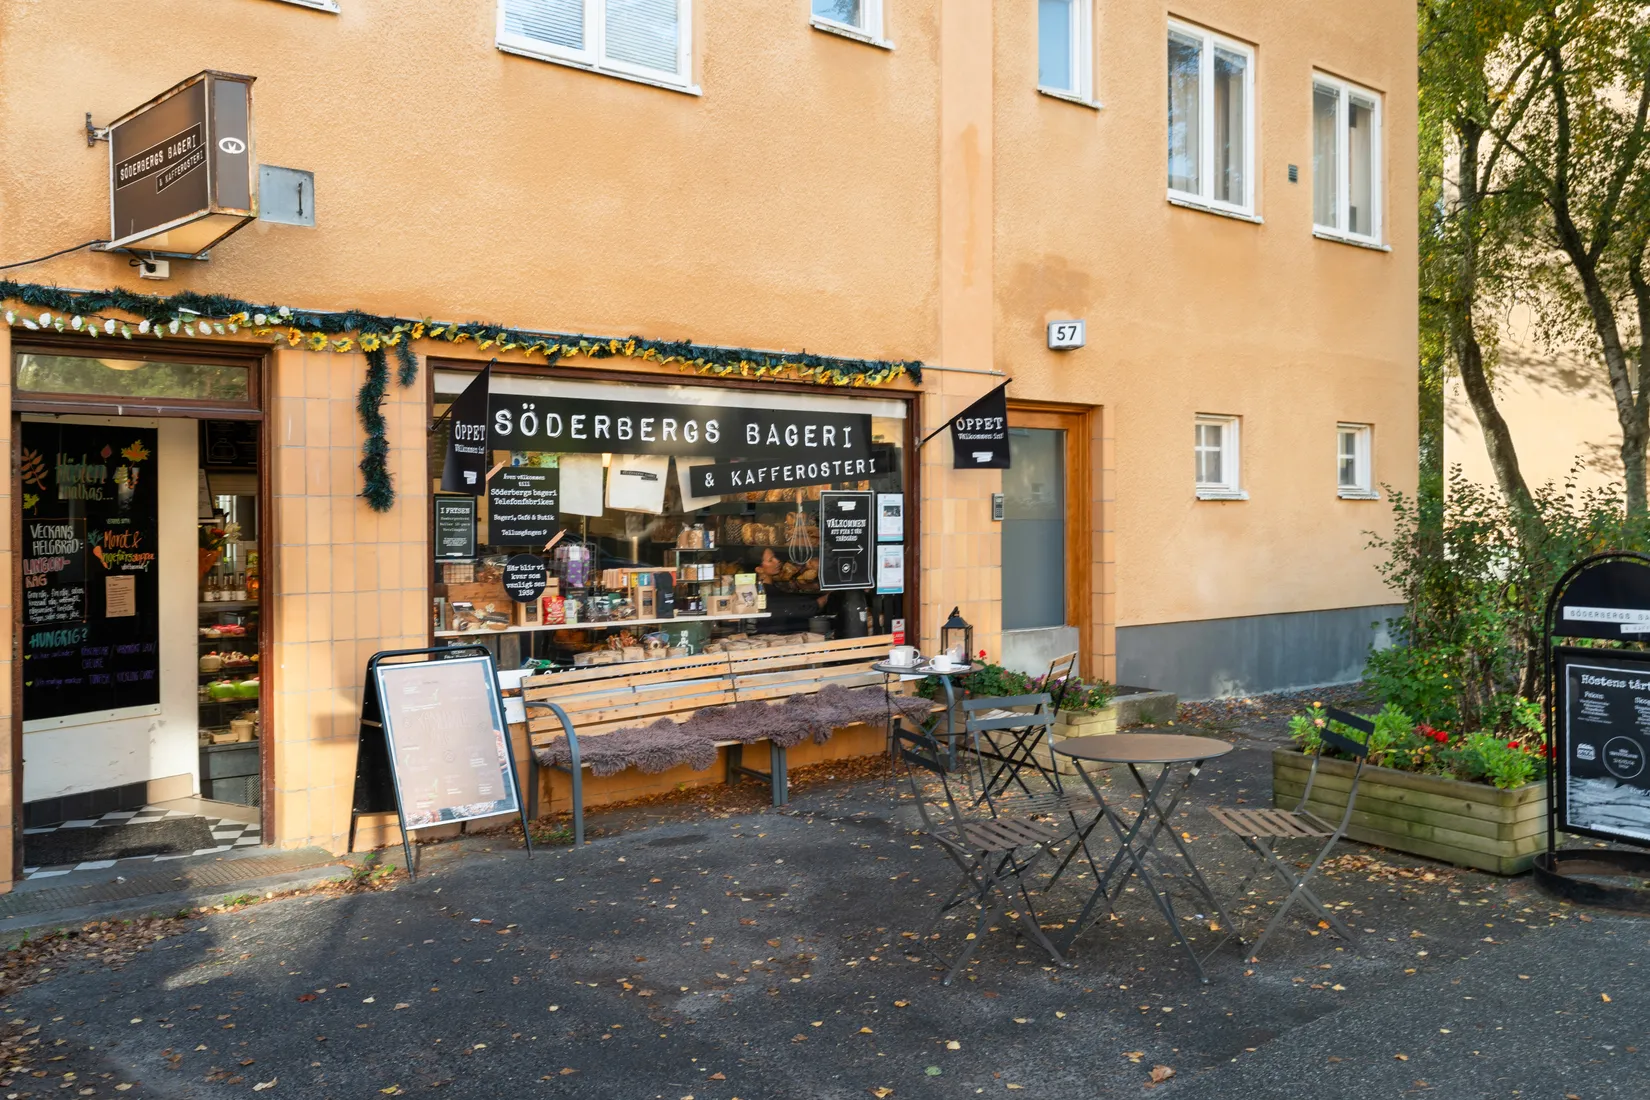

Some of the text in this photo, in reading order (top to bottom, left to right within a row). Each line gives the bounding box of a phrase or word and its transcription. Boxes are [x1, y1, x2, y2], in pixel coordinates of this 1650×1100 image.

[120, 134, 197, 181] SÖDERBERGS BAGERI
[164, 150, 204, 184] KAFFEROSTERI
[1056, 325, 1077, 341] 57
[454, 420, 486, 441] ÖPPET
[494, 402, 853, 449] SÖDERBERGS BAGERI
[955, 416, 1004, 431] ÖPPET
[704, 457, 877, 488] & KAFFEROSTERI
[490, 488, 558, 498] Söderbergs bageri
[826, 518, 866, 528] VÄLKOMMEN
[30, 523, 74, 540] VECKANS
[506, 581, 533, 589] vanligt
[1570, 609, 1631, 620] SÖDERBERGS
[1581, 674, 1627, 689] Höstens
